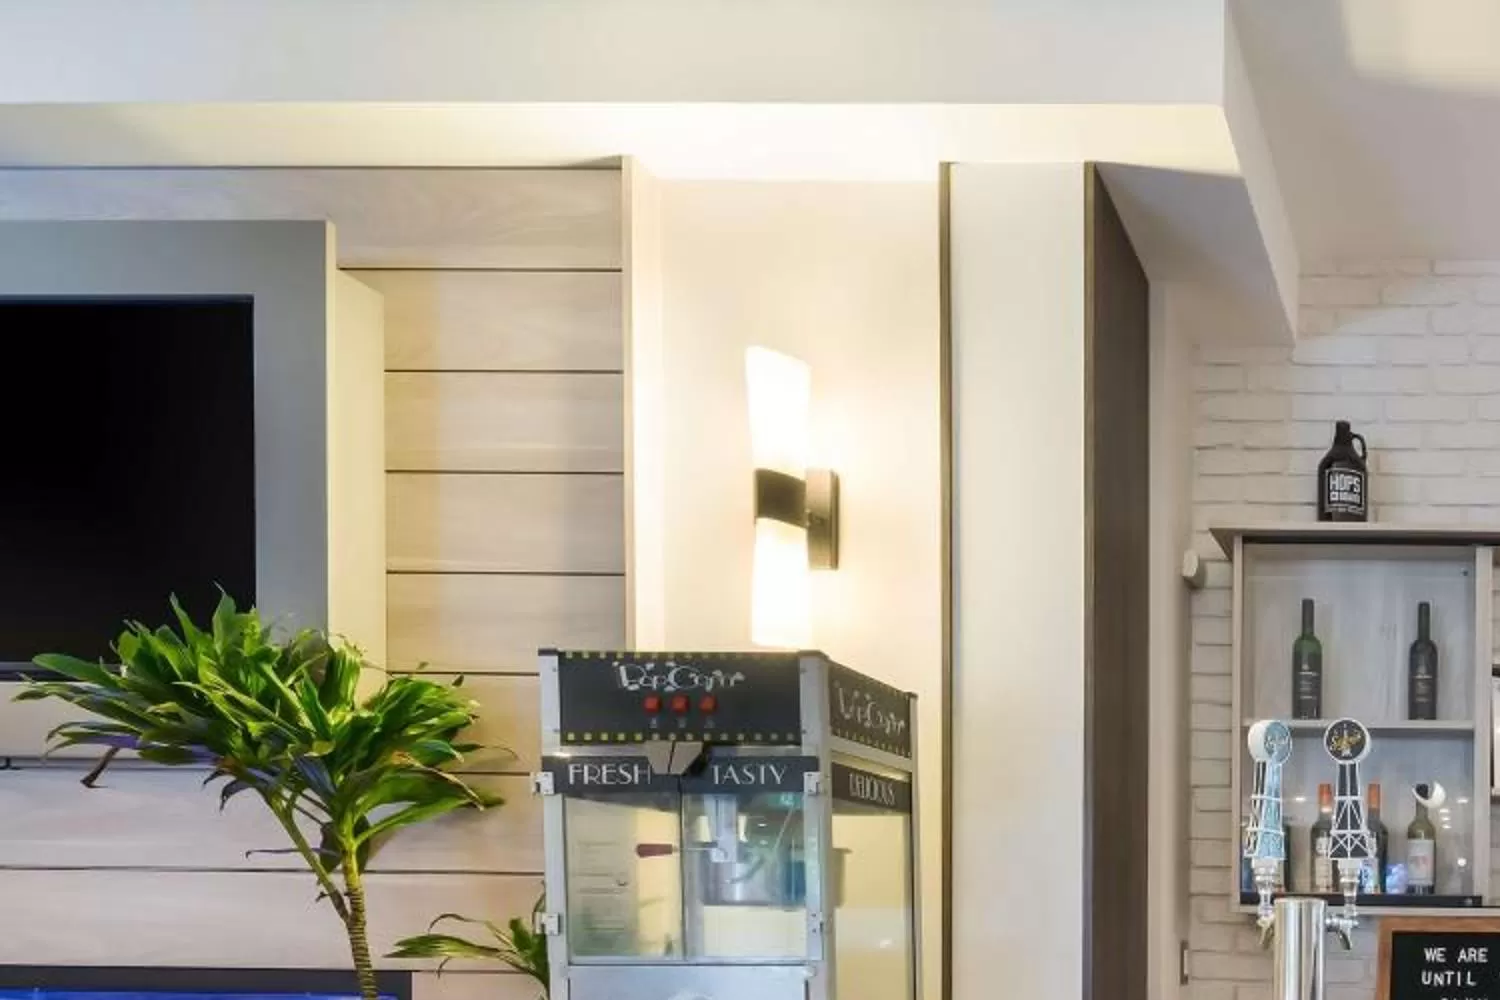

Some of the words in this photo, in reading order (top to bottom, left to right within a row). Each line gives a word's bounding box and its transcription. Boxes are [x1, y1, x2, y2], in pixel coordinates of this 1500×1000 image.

[568, 763, 651, 785] FRESH
[711, 763, 788, 785] TASTY
[1424, 947, 1446, 963] WE
[1457, 947, 1489, 963] ARE
[1421, 971, 1477, 987] UNTIL
